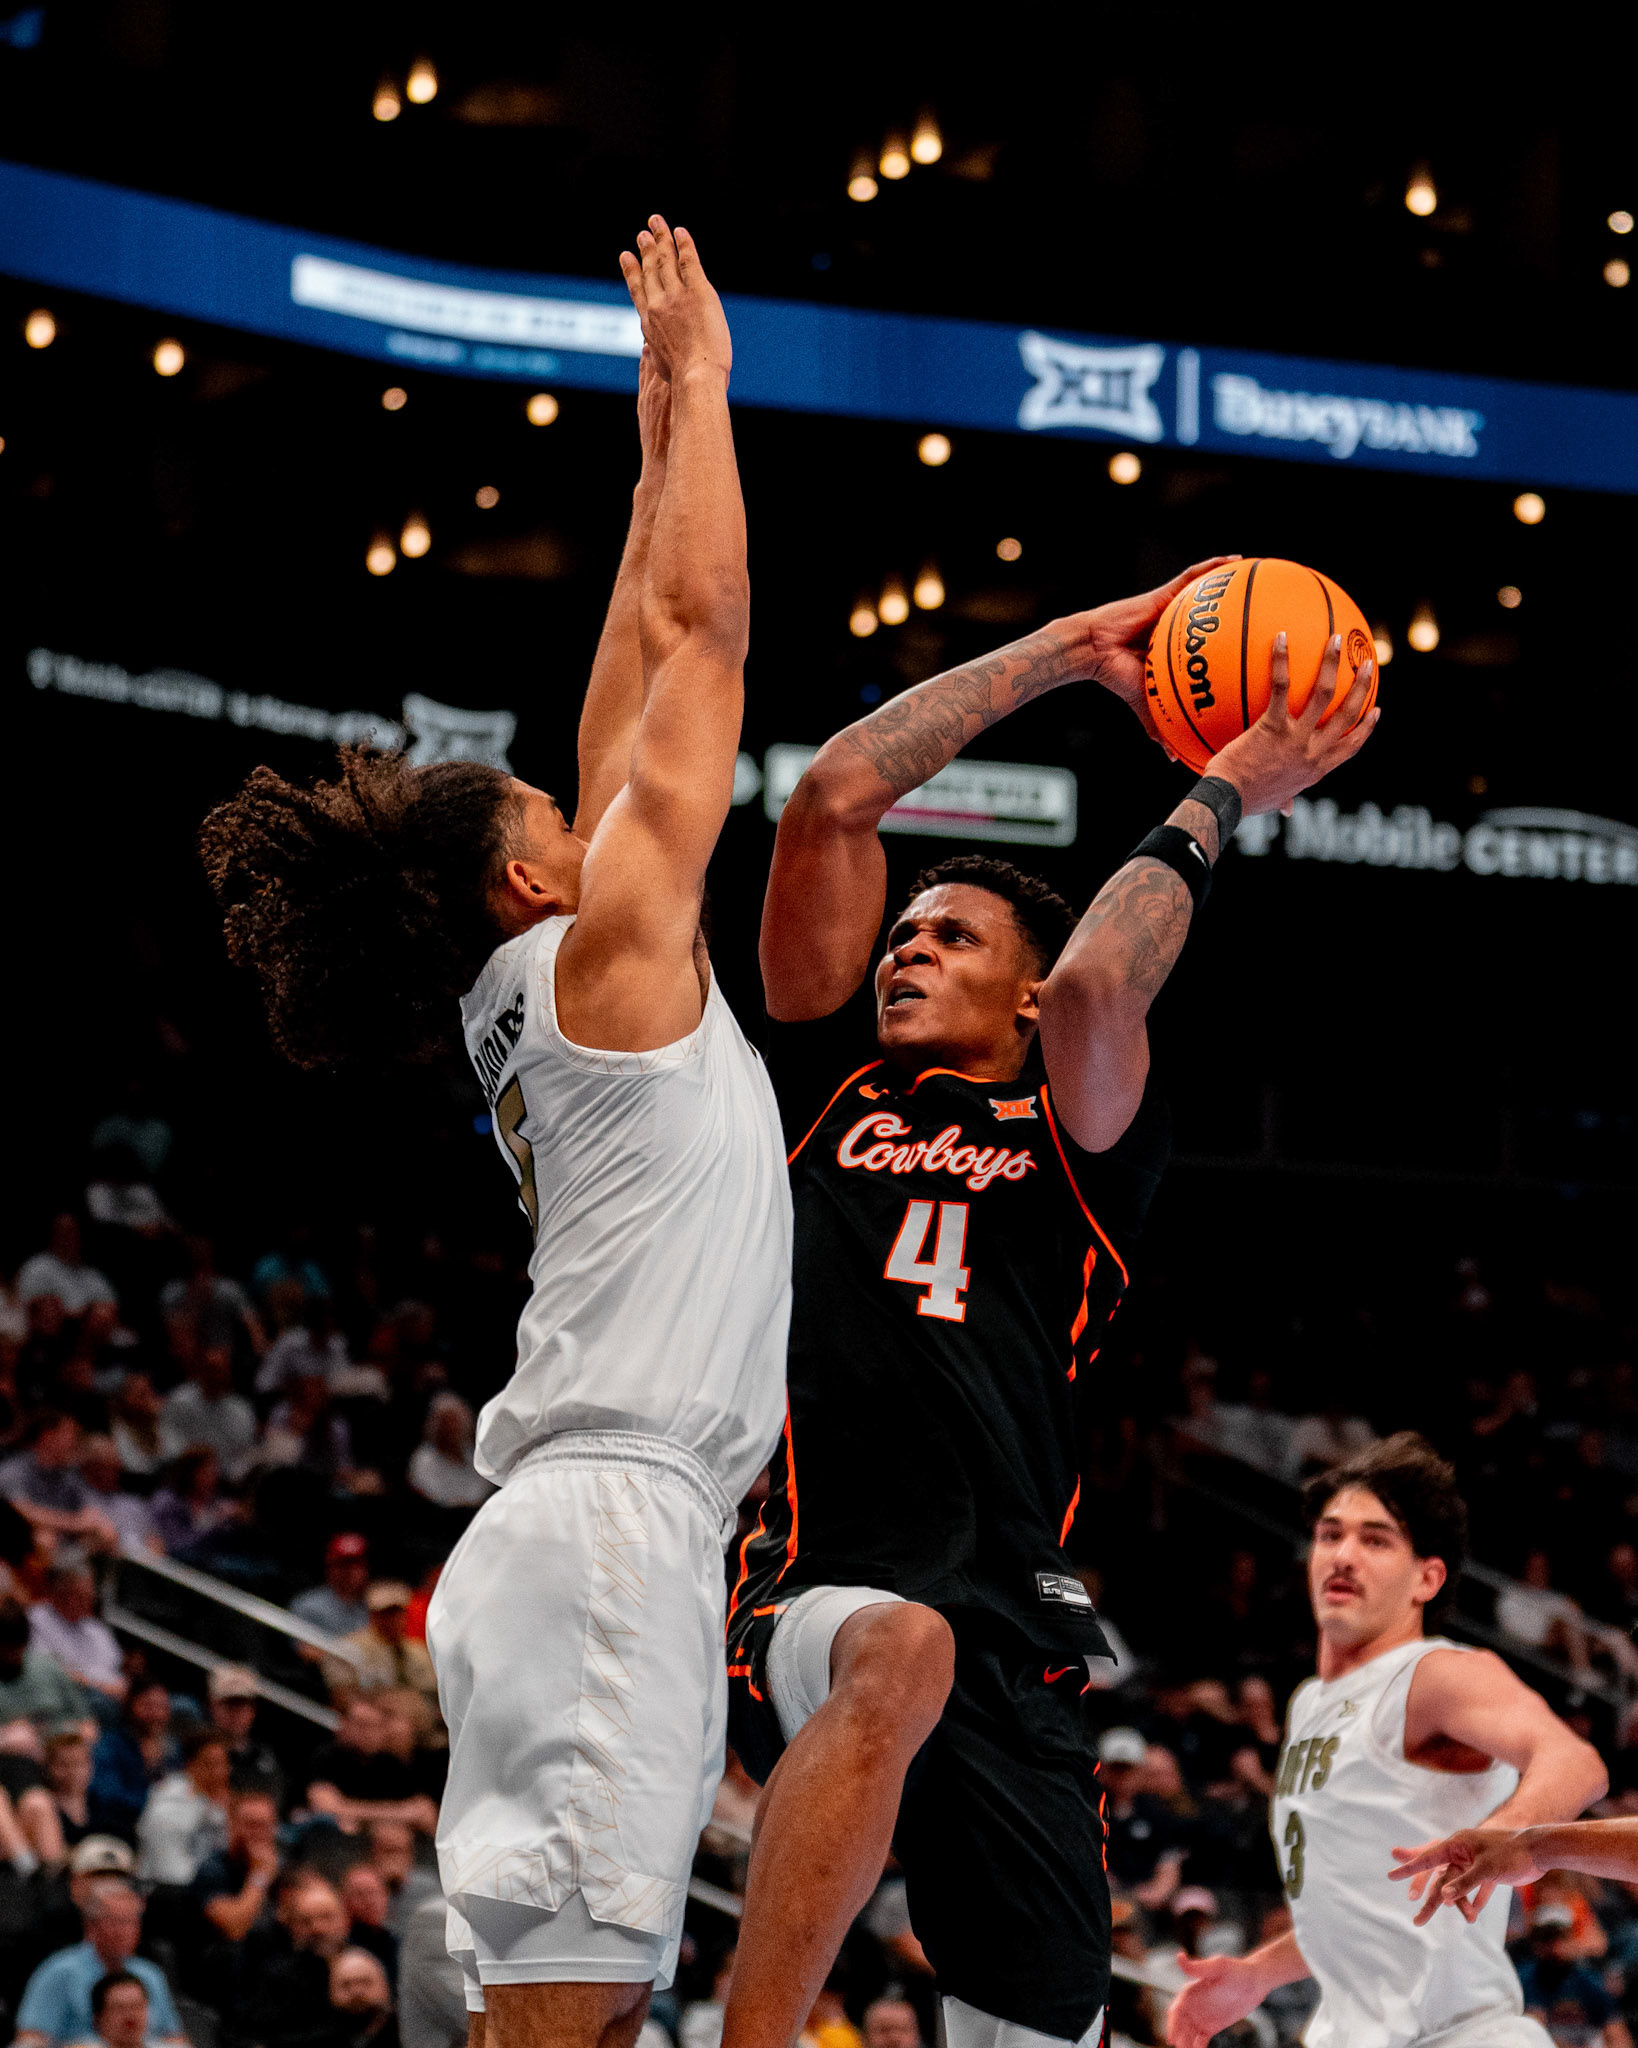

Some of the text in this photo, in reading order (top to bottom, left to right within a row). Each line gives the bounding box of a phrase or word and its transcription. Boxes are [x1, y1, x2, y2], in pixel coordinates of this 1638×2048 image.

[1185, 569, 1237, 713] Wilson
[837, 1111, 1038, 1192] Cowboys
[884, 1199, 971, 1323] 4
